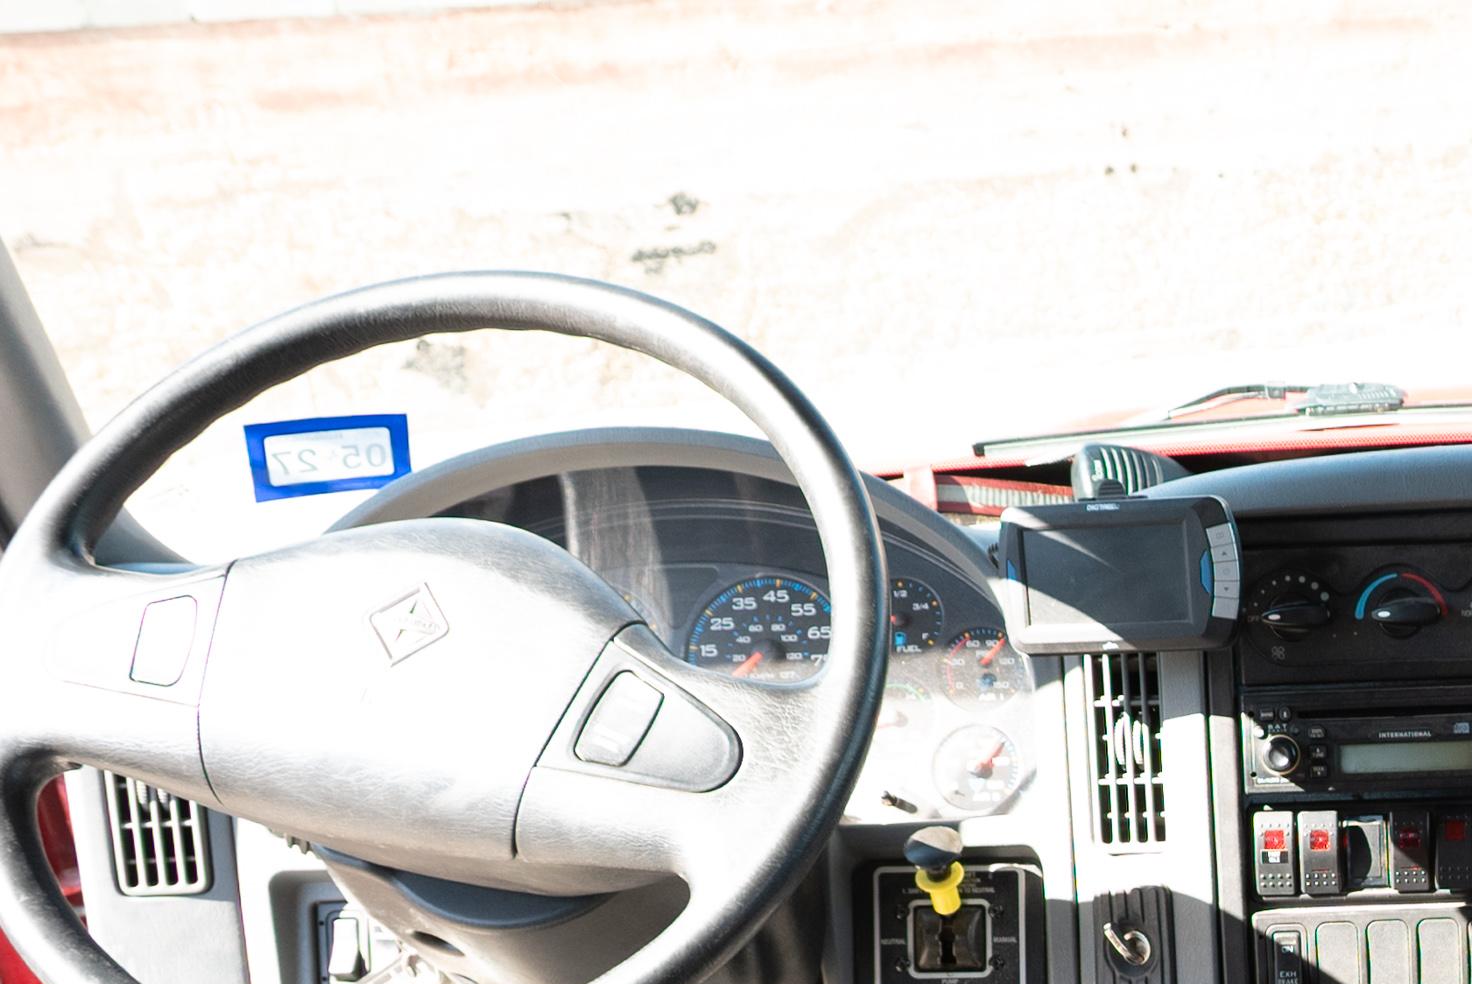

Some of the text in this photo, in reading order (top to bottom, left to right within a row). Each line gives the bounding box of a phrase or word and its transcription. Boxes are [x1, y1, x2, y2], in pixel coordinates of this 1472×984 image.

[762, 589, 790, 602] 45
[732, 597, 757, 610] 35
[791, 603, 816, 616] 55
[710, 617, 735, 631] 25
[808, 626, 832, 639] 65
[700, 644, 718, 657] 15
[1378, 730, 1432, 739] INTERNATIONAL
[1280, 970, 1297, 978] EXH
